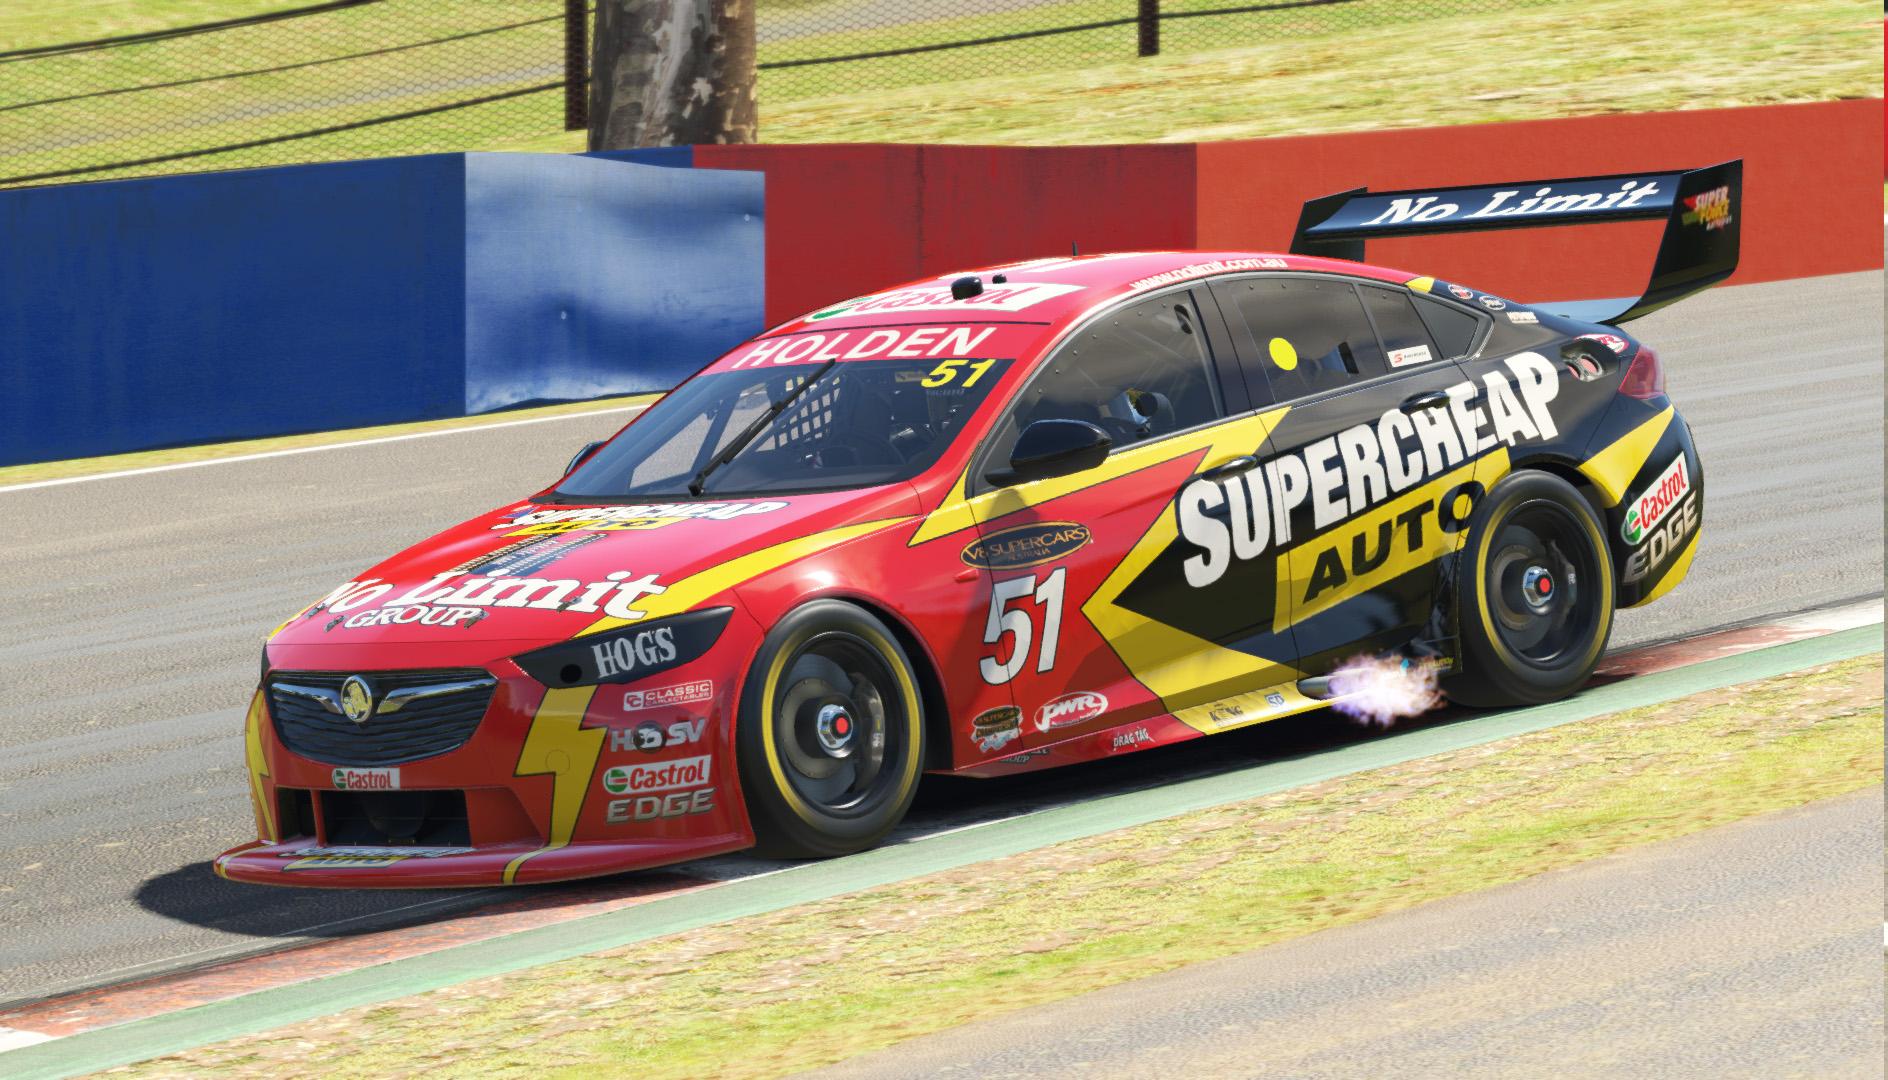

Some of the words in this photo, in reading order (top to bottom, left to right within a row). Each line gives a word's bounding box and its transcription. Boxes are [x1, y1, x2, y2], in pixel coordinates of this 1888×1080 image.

[1359, 196, 1459, 227] No
[1464, 181, 1660, 219] Limit
[731, 326, 998, 369] HOLDEN
[921, 358, 997, 388] 51
[1179, 351, 1560, 589] SUPERCHEAP
[1640, 462, 1687, 529] Castrol
[989, 526, 1090, 556] SUPERCARS
[1302, 479, 1488, 604] AUTO
[1623, 489, 1699, 583] EDGE
[344, 604, 485, 629] GROUP
[383, 570, 668, 620] Limit
[979, 566, 1067, 686] 51
[591, 627, 677, 680] HOGS
[645, 683, 710, 701] CLASSIC
[347, 769, 394, 789] Castrol
[629, 760, 705, 790] Castrol
[606, 788, 716, 824] EDGE
